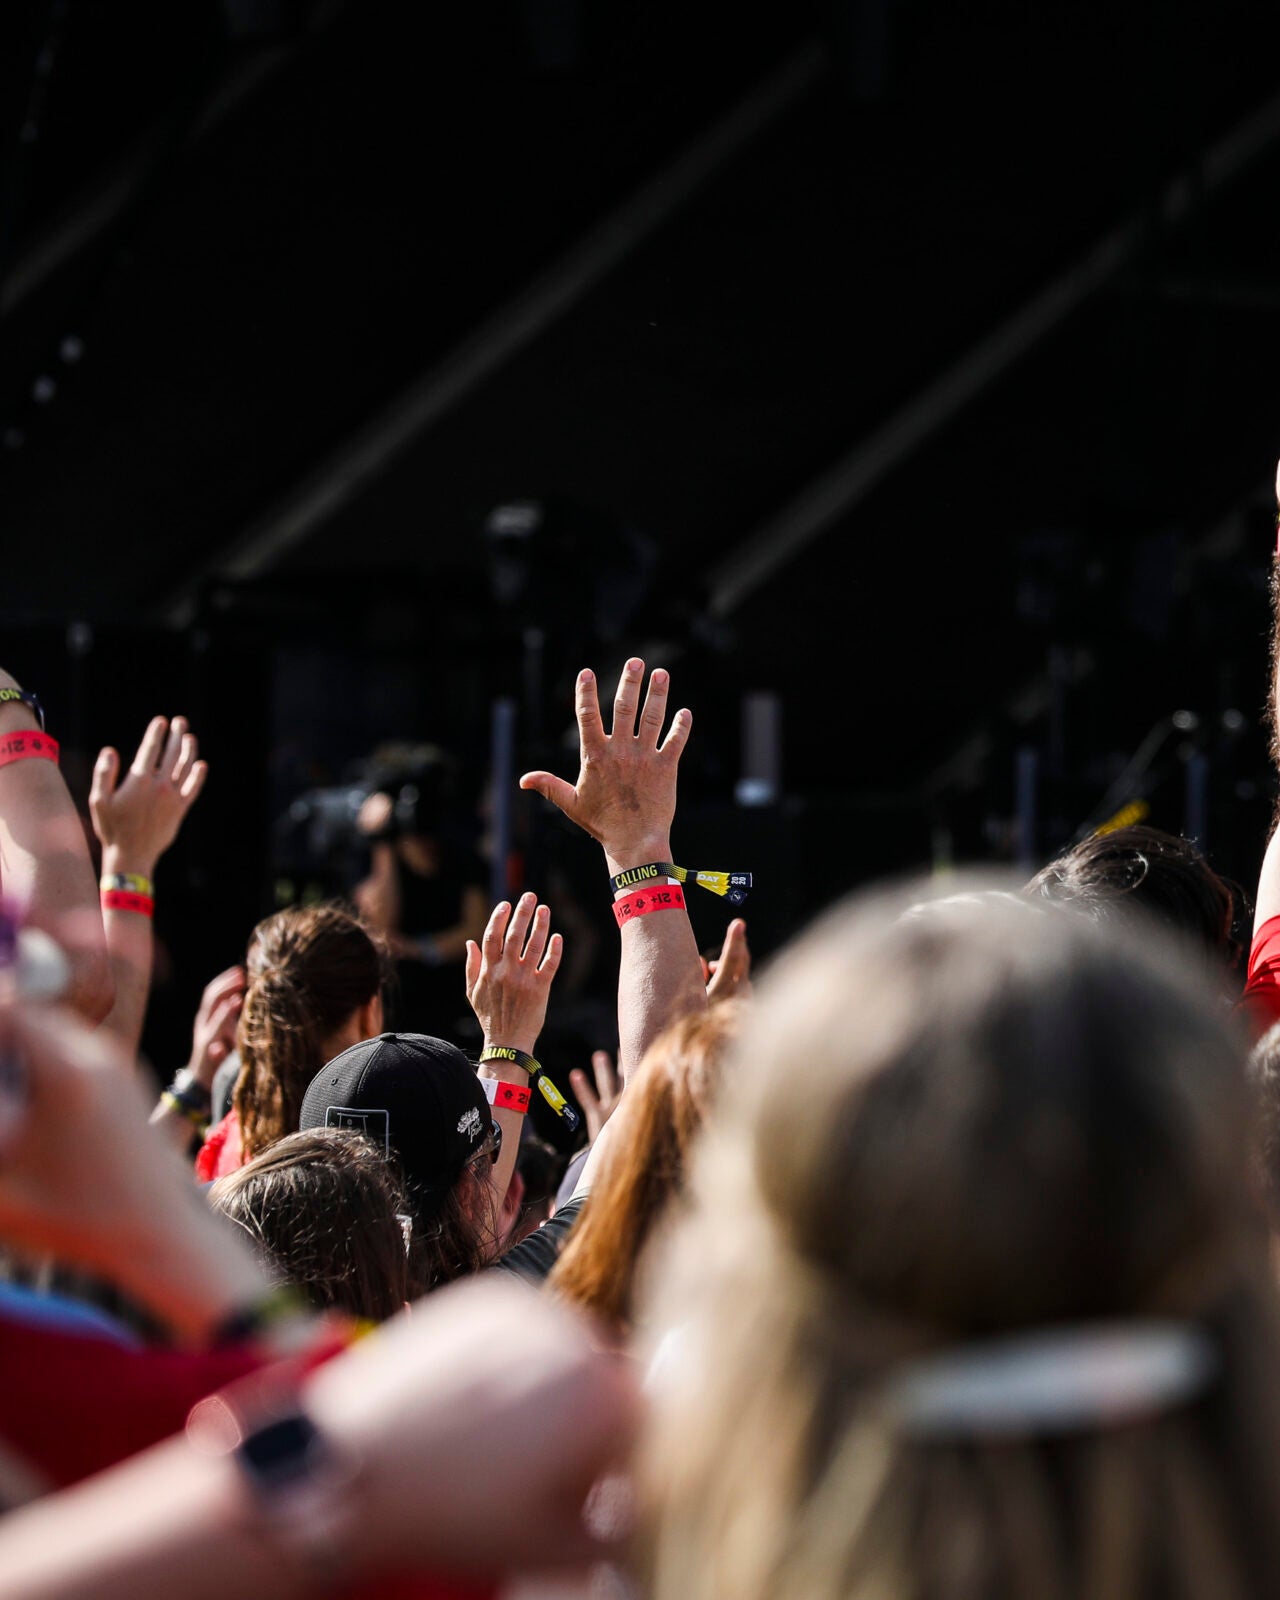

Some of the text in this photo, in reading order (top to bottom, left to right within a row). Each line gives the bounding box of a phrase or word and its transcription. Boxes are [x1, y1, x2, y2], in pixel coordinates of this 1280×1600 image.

[615, 865, 658, 889] CALLING
[617, 893, 671, 918] 21+ 21+
